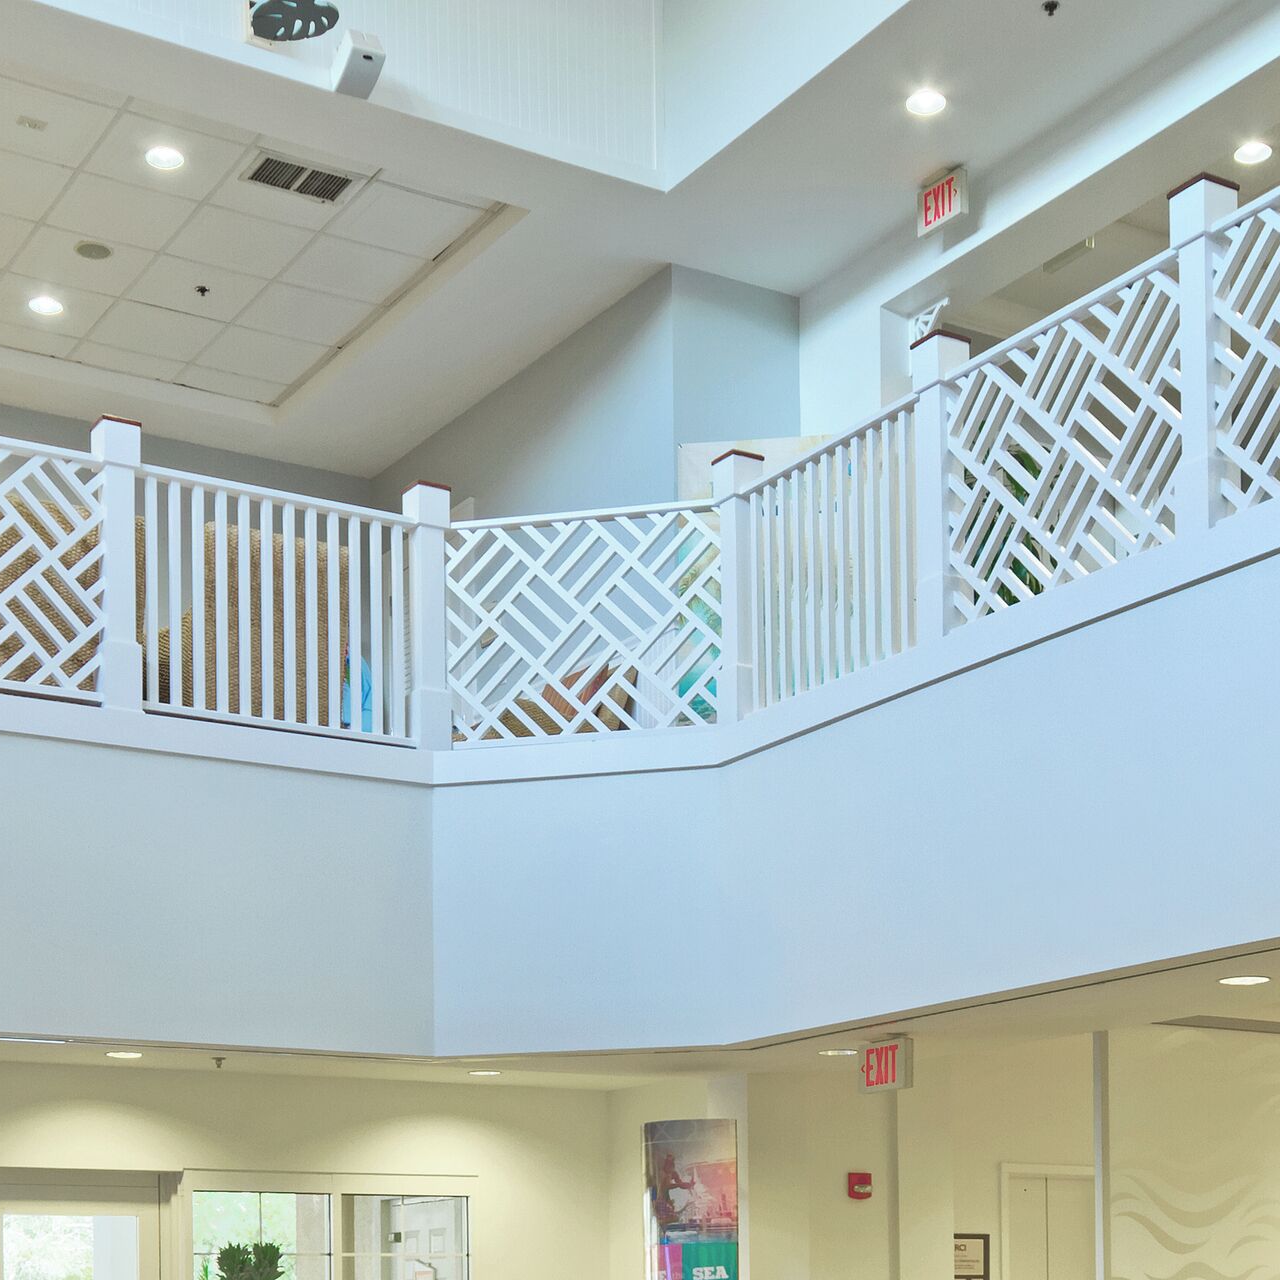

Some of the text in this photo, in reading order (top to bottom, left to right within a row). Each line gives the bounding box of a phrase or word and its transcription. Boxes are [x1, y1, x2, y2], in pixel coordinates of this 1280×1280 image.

[923, 175, 955, 228] EXIT
[865, 1044, 899, 1087] EXIT
[692, 1265, 729, 1280] SEA
